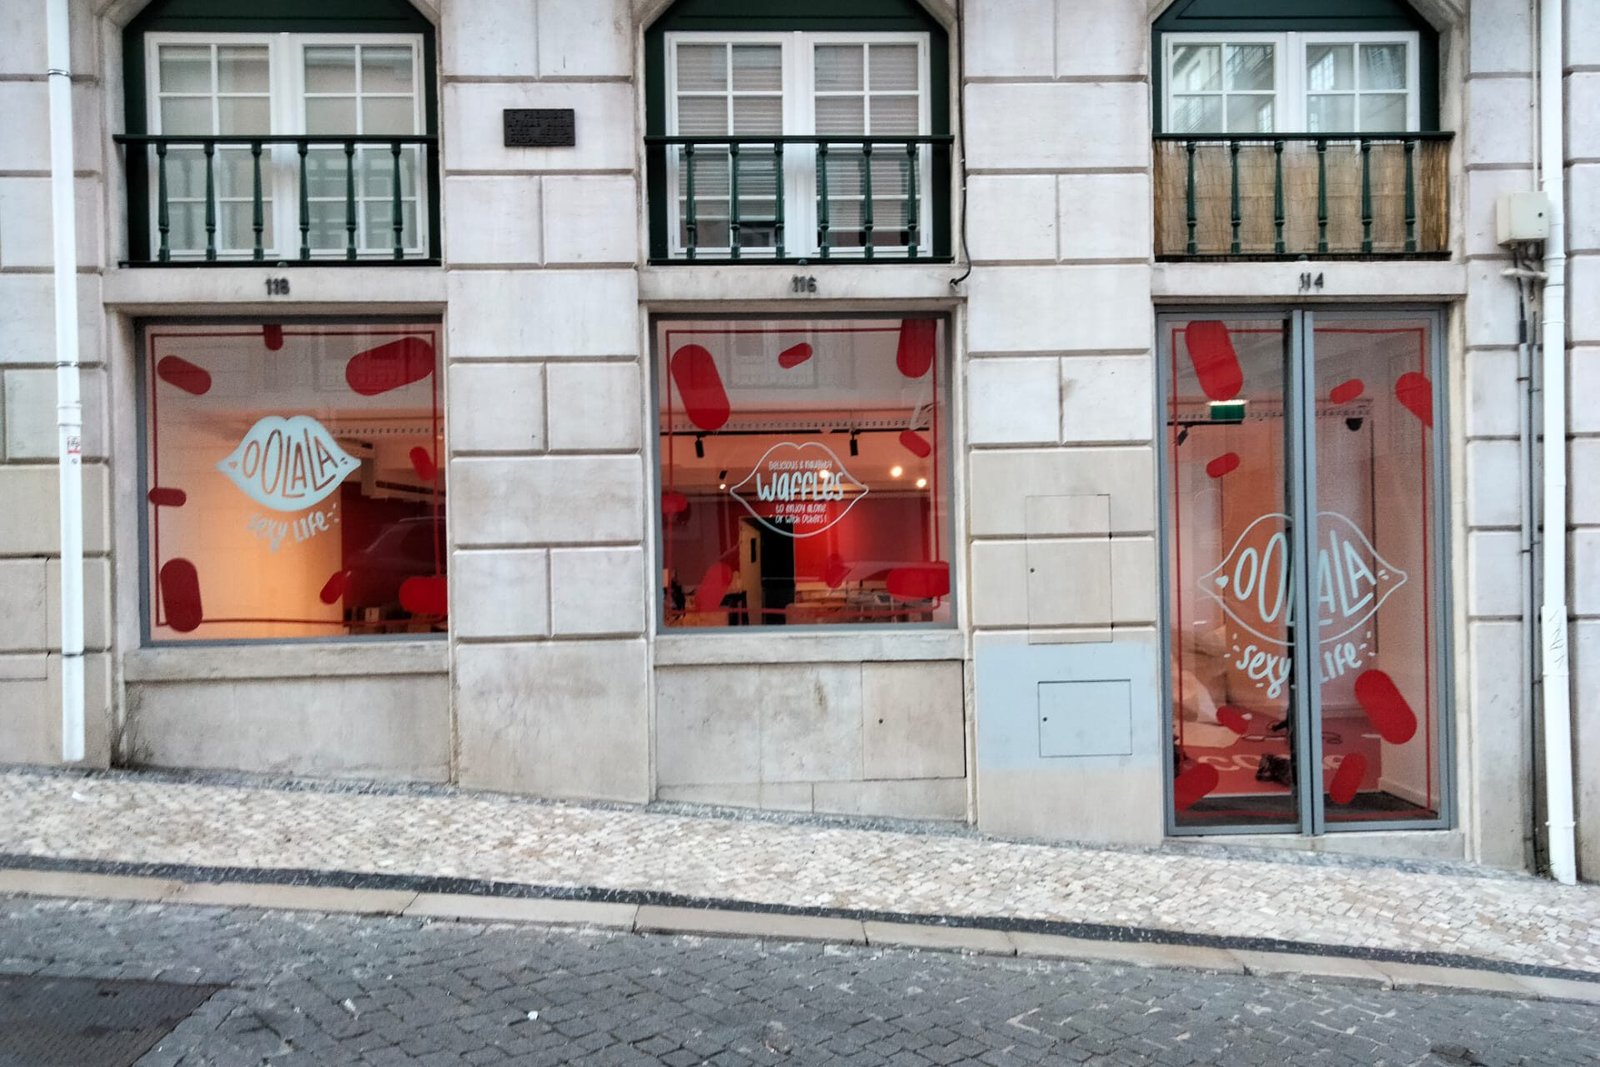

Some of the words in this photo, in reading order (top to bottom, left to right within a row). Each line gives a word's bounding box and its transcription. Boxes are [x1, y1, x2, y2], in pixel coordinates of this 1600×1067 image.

[265, 278, 290, 296] 118
[792, 275, 817, 293] 116
[1299, 271, 1323, 289] 114
[242, 427, 339, 499] OOLALA
